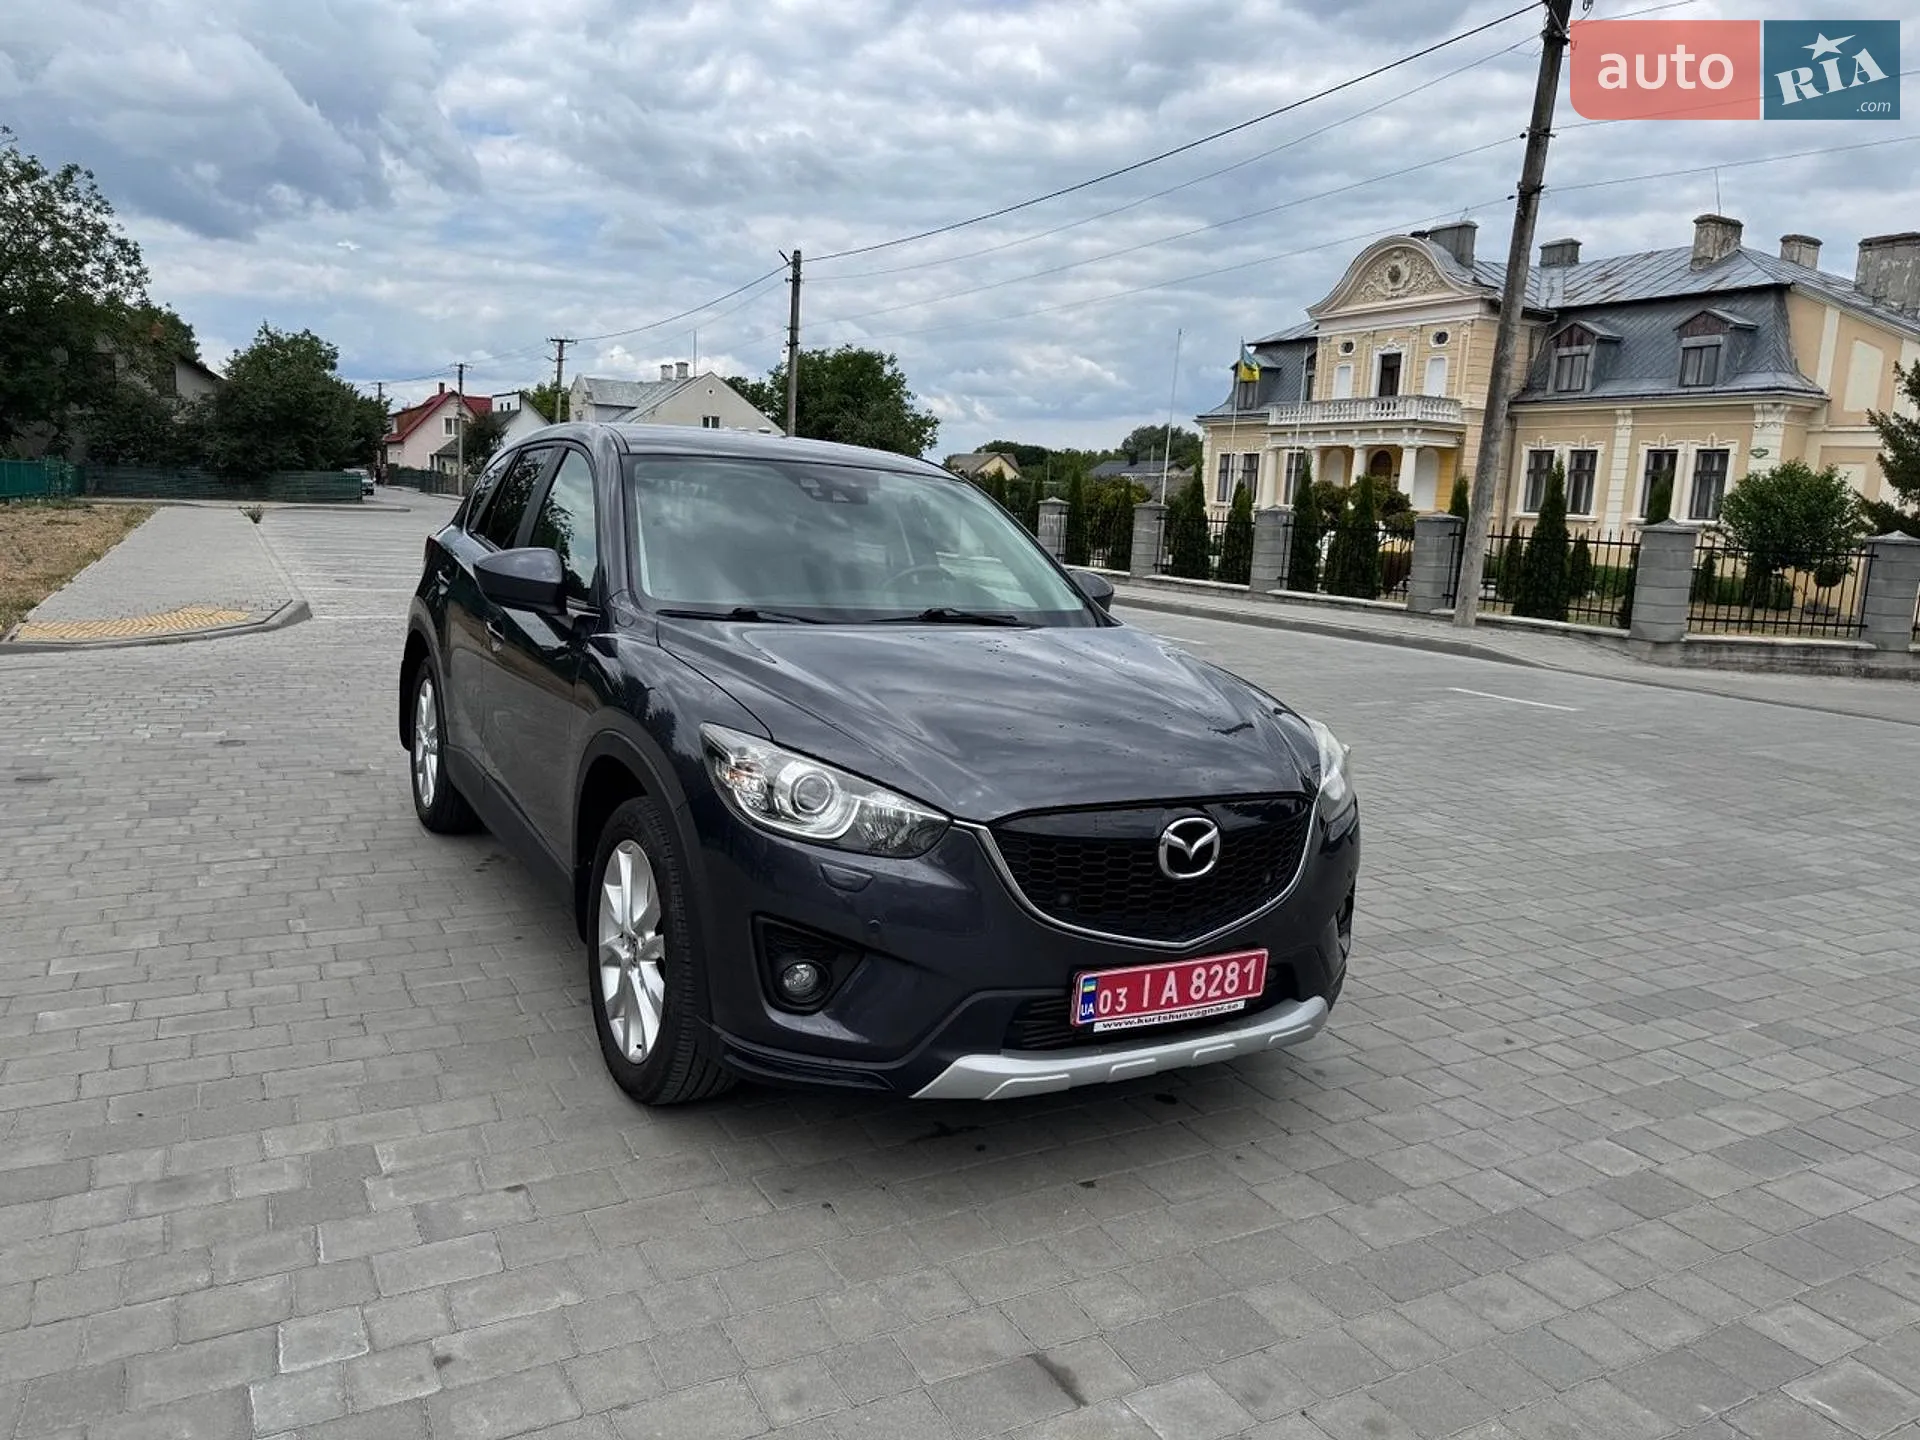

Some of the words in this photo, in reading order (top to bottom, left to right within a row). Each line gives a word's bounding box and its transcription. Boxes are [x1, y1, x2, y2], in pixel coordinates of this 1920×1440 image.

[1099, 988, 1128, 1014] 03
[1189, 959, 1257, 1000] 8281
[1081, 1004, 1095, 1017] UA
